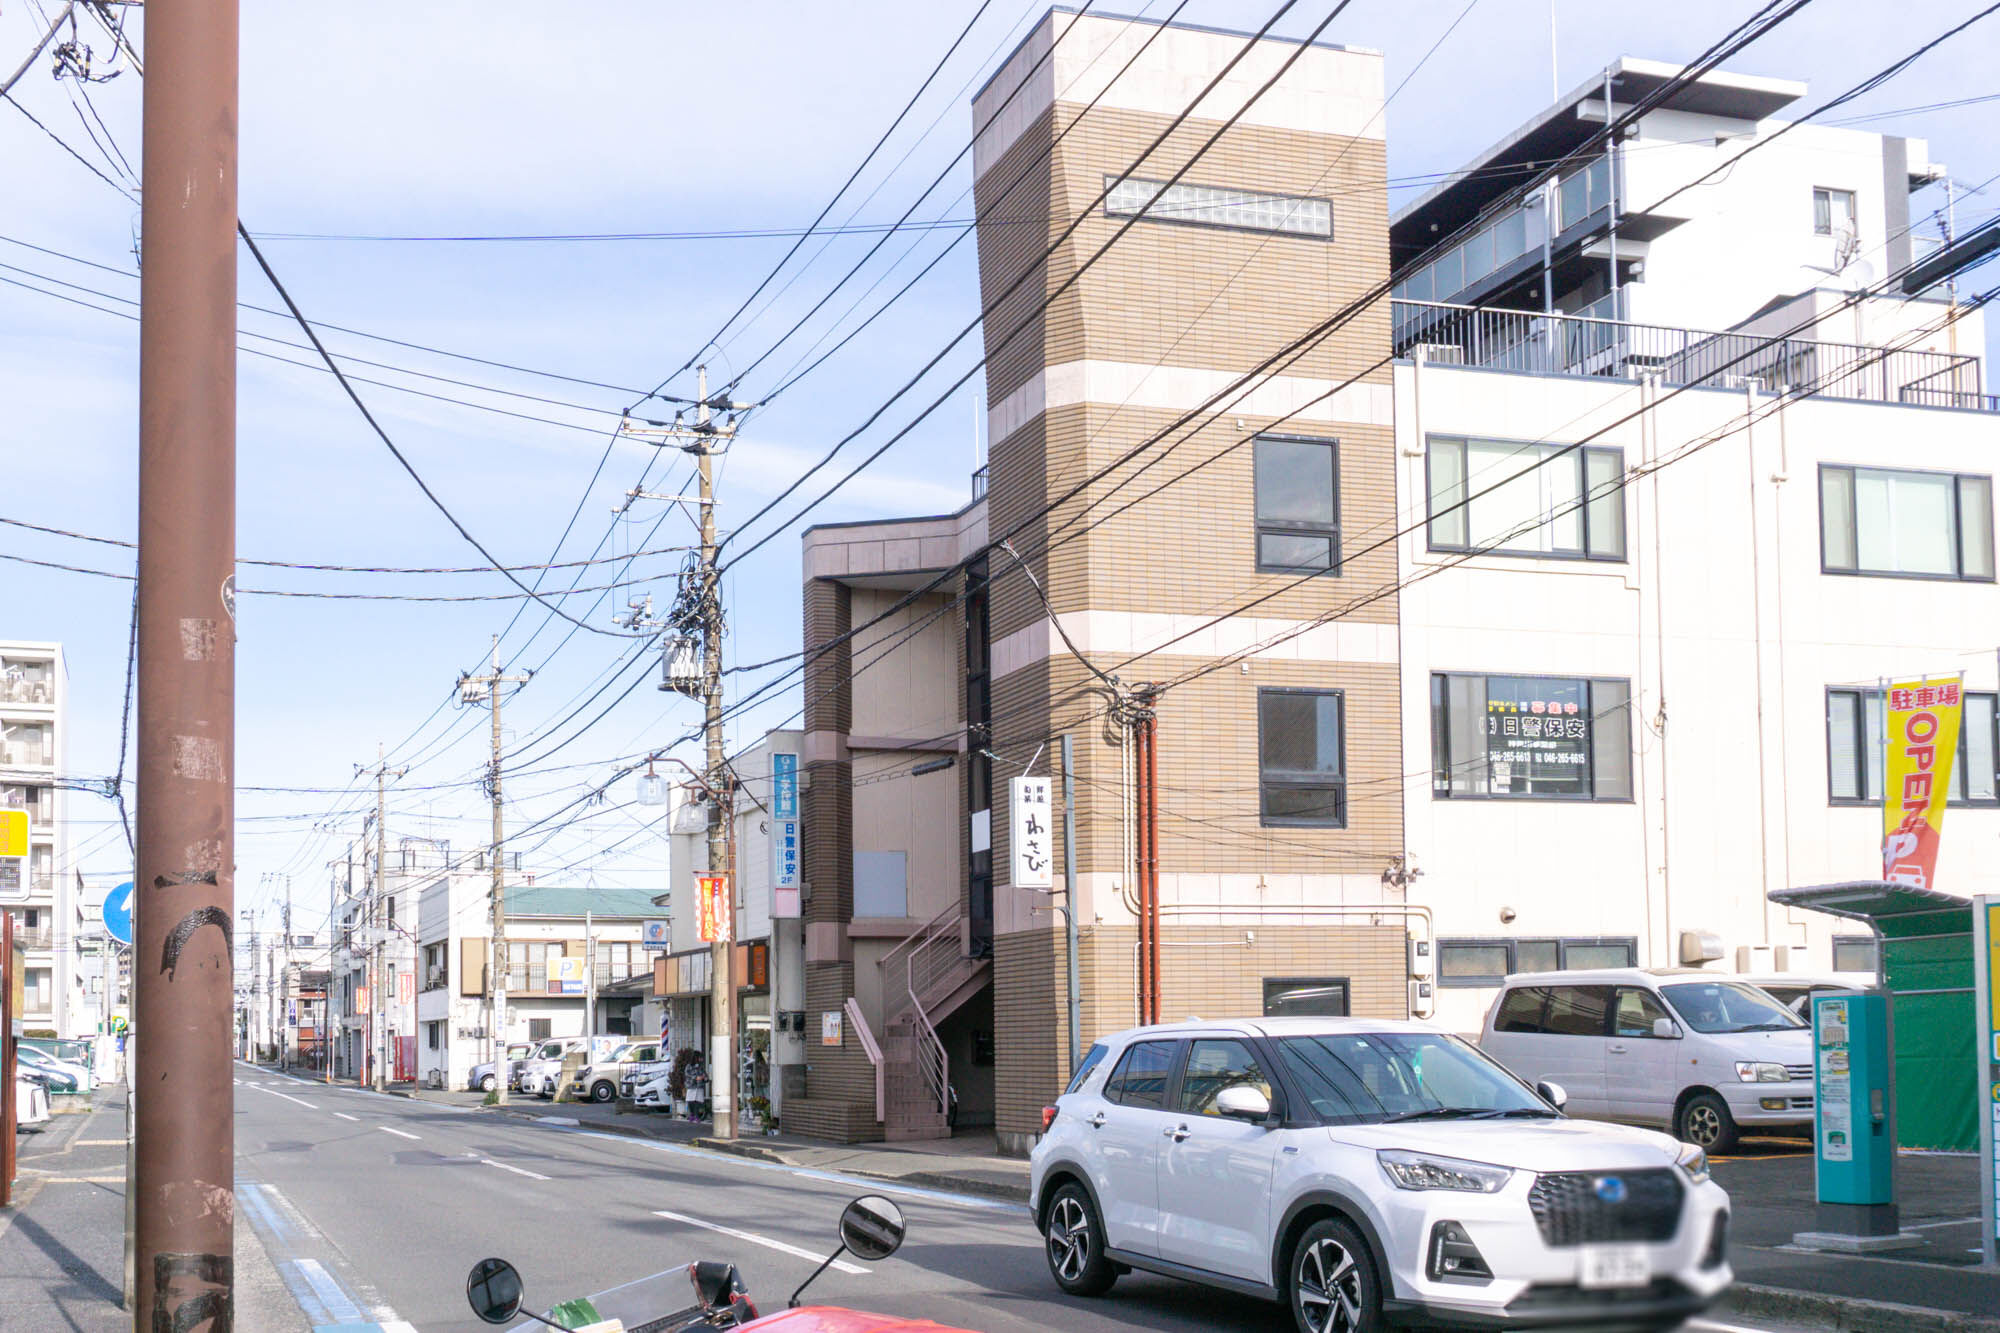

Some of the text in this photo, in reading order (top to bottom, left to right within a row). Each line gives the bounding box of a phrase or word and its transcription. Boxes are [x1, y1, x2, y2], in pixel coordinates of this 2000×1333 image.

[1888, 682, 1961, 712] 駐車場
[1901, 711, 1939, 834] OPEN
[1022, 813, 1048, 872] わさび
